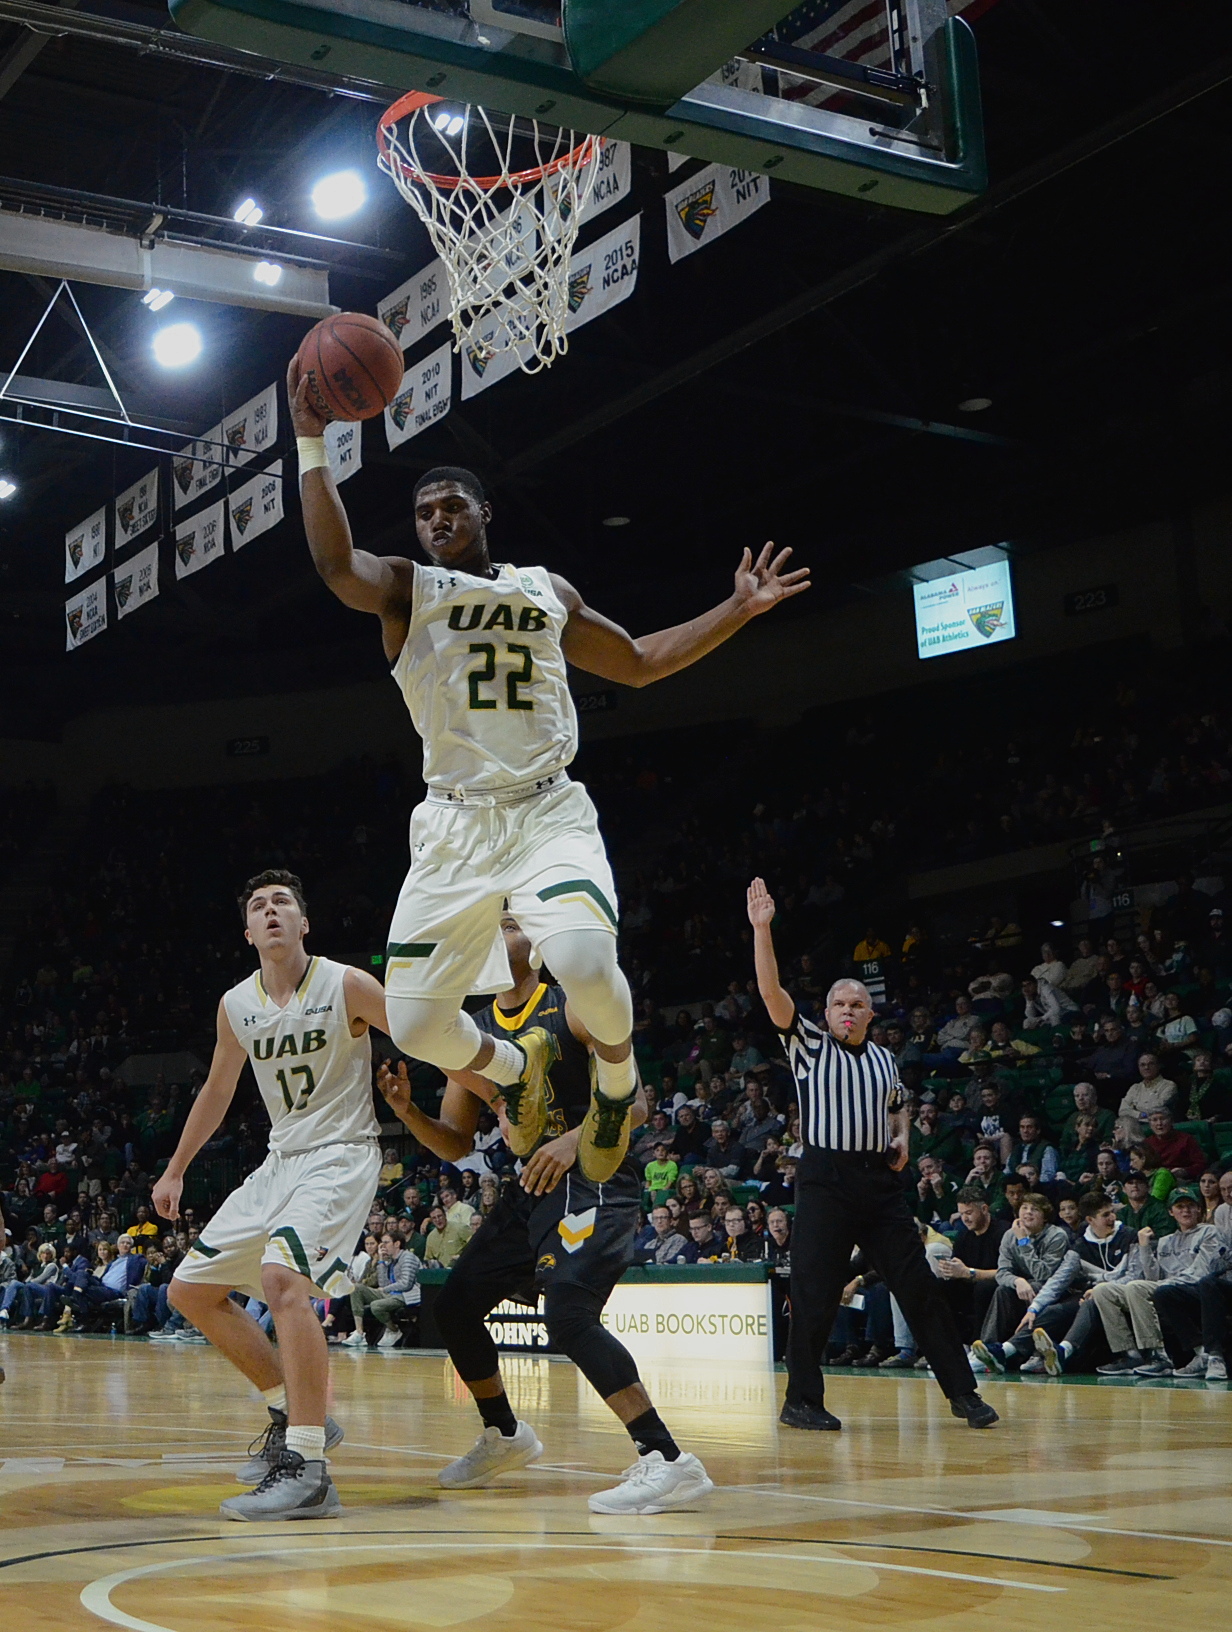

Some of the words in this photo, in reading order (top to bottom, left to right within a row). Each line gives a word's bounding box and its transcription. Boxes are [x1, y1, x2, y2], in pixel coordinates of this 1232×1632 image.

[597, 143, 617, 174] 987
[593, 173, 619, 205] NCAA
[736, 176, 761, 204] NIT
[604, 240, 634, 271] 2015
[602, 258, 638, 290] NCAA
[422, 362, 440, 386] 2010
[425, 383, 438, 402] NIT
[337, 428, 354, 448] 2009
[340, 449, 352, 465] NIT
[262, 480, 276, 499] 2008
[264, 498, 275, 514] NIT
[1074, 590, 1106, 611] 223
[448, 604, 548, 631] UAB
[921, 624, 940, 635] Proud
[941, 620, 966, 632] Sponsor
[920, 639, 926, 648] of
[928, 635, 940, 646] UAB
[942, 630, 969, 643] Athletics
[468, 643, 534, 710] 22
[579, 695, 607, 710] 224
[234, 740, 260, 754] 225
[1112, 894, 1130, 907] 116
[863, 962, 878, 975] 116
[305, 1005, 332, 1016] C-USA
[253, 1029, 327, 1060] UAB
[276, 1064, 316, 1114] 13
[484, 1322, 550, 1347] OHN'S
[616, 1314, 650, 1334] UAB
[656, 1314, 768, 1336] BOOKSTORE
